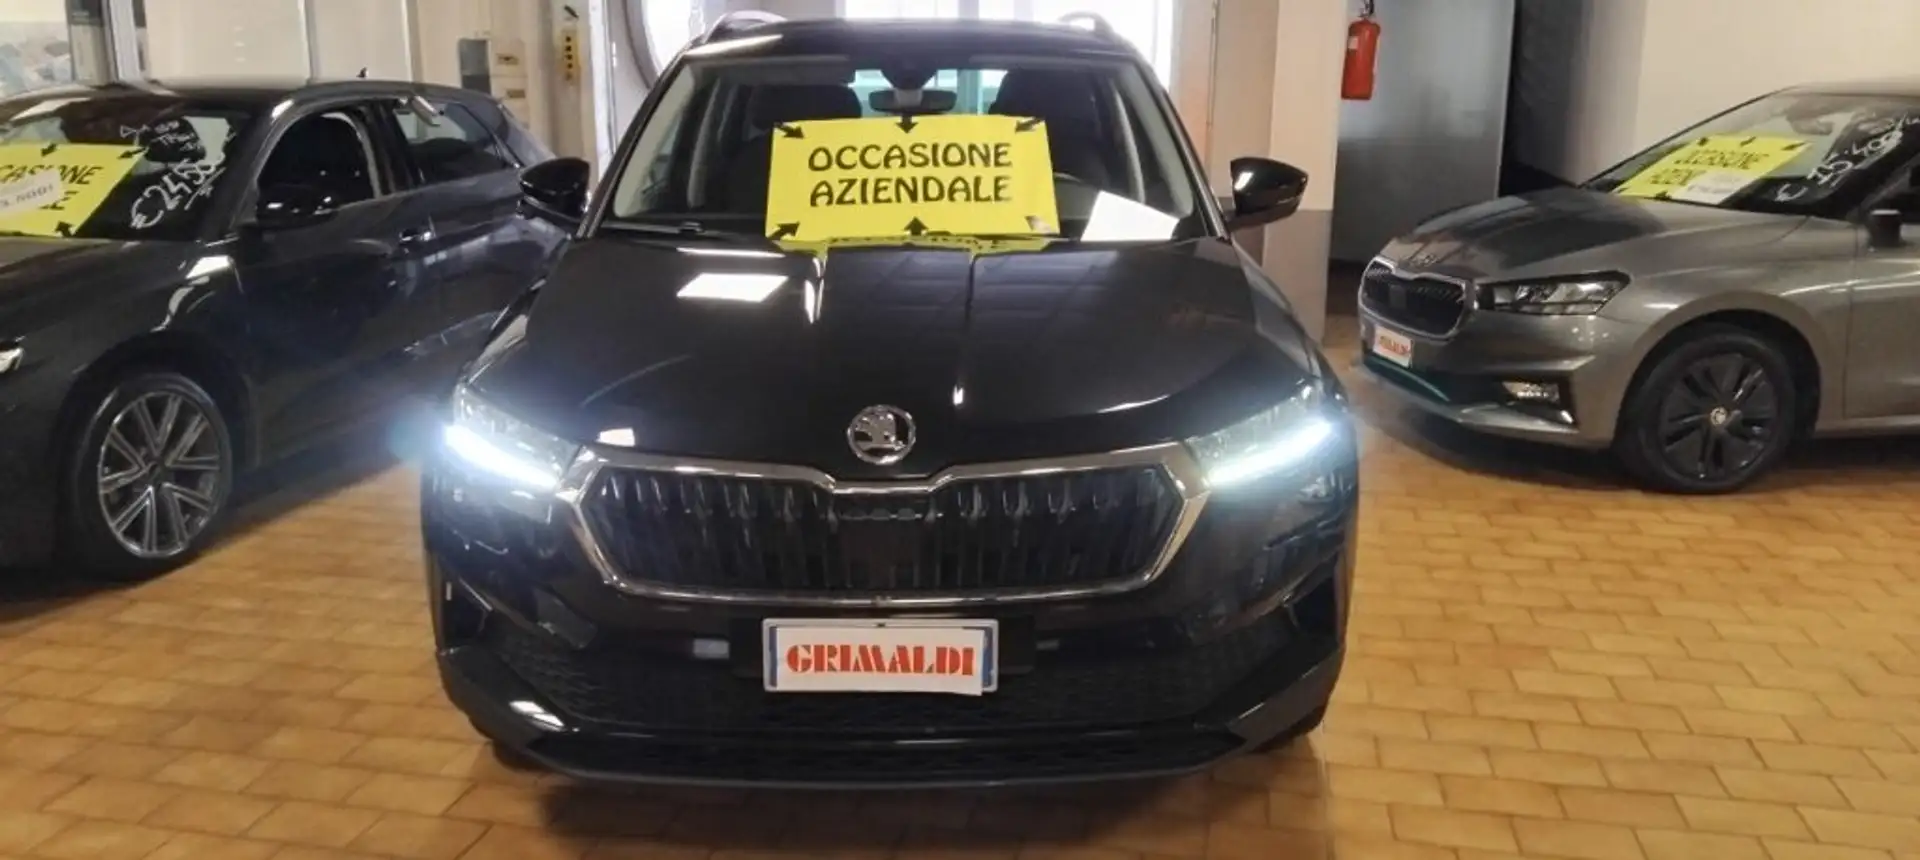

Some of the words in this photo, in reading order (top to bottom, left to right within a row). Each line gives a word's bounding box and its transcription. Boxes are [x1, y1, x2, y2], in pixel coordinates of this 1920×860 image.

[808, 143, 1012, 172] OCCASIONE
[810, 176, 1012, 207] AZIENDALE
[786, 644, 974, 676] GRIMALDI
